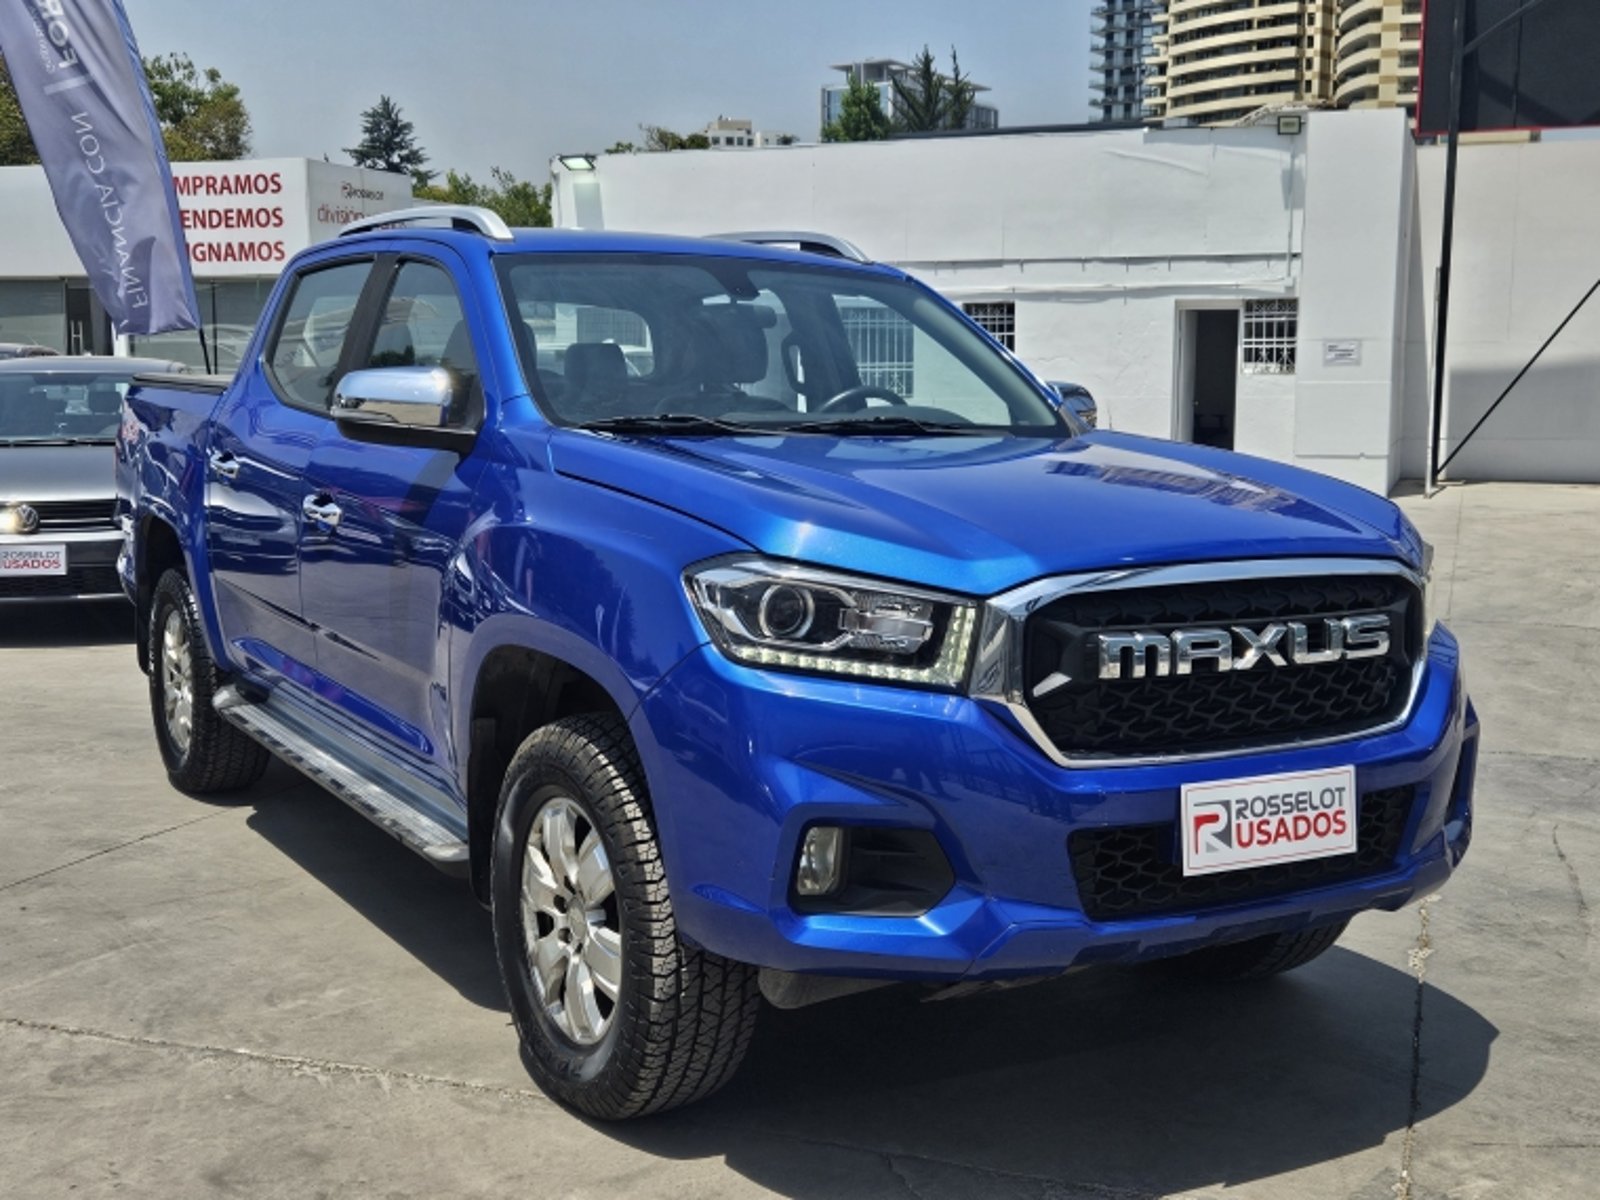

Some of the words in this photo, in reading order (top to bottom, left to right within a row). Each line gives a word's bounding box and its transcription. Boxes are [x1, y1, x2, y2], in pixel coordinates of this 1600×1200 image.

[3, 559, 61, 569] USADOS
[1099, 613, 1391, 680] MAXUS
[1235, 787, 1345, 820] ROSSELOT
[1235, 809, 1347, 849] USADOS
